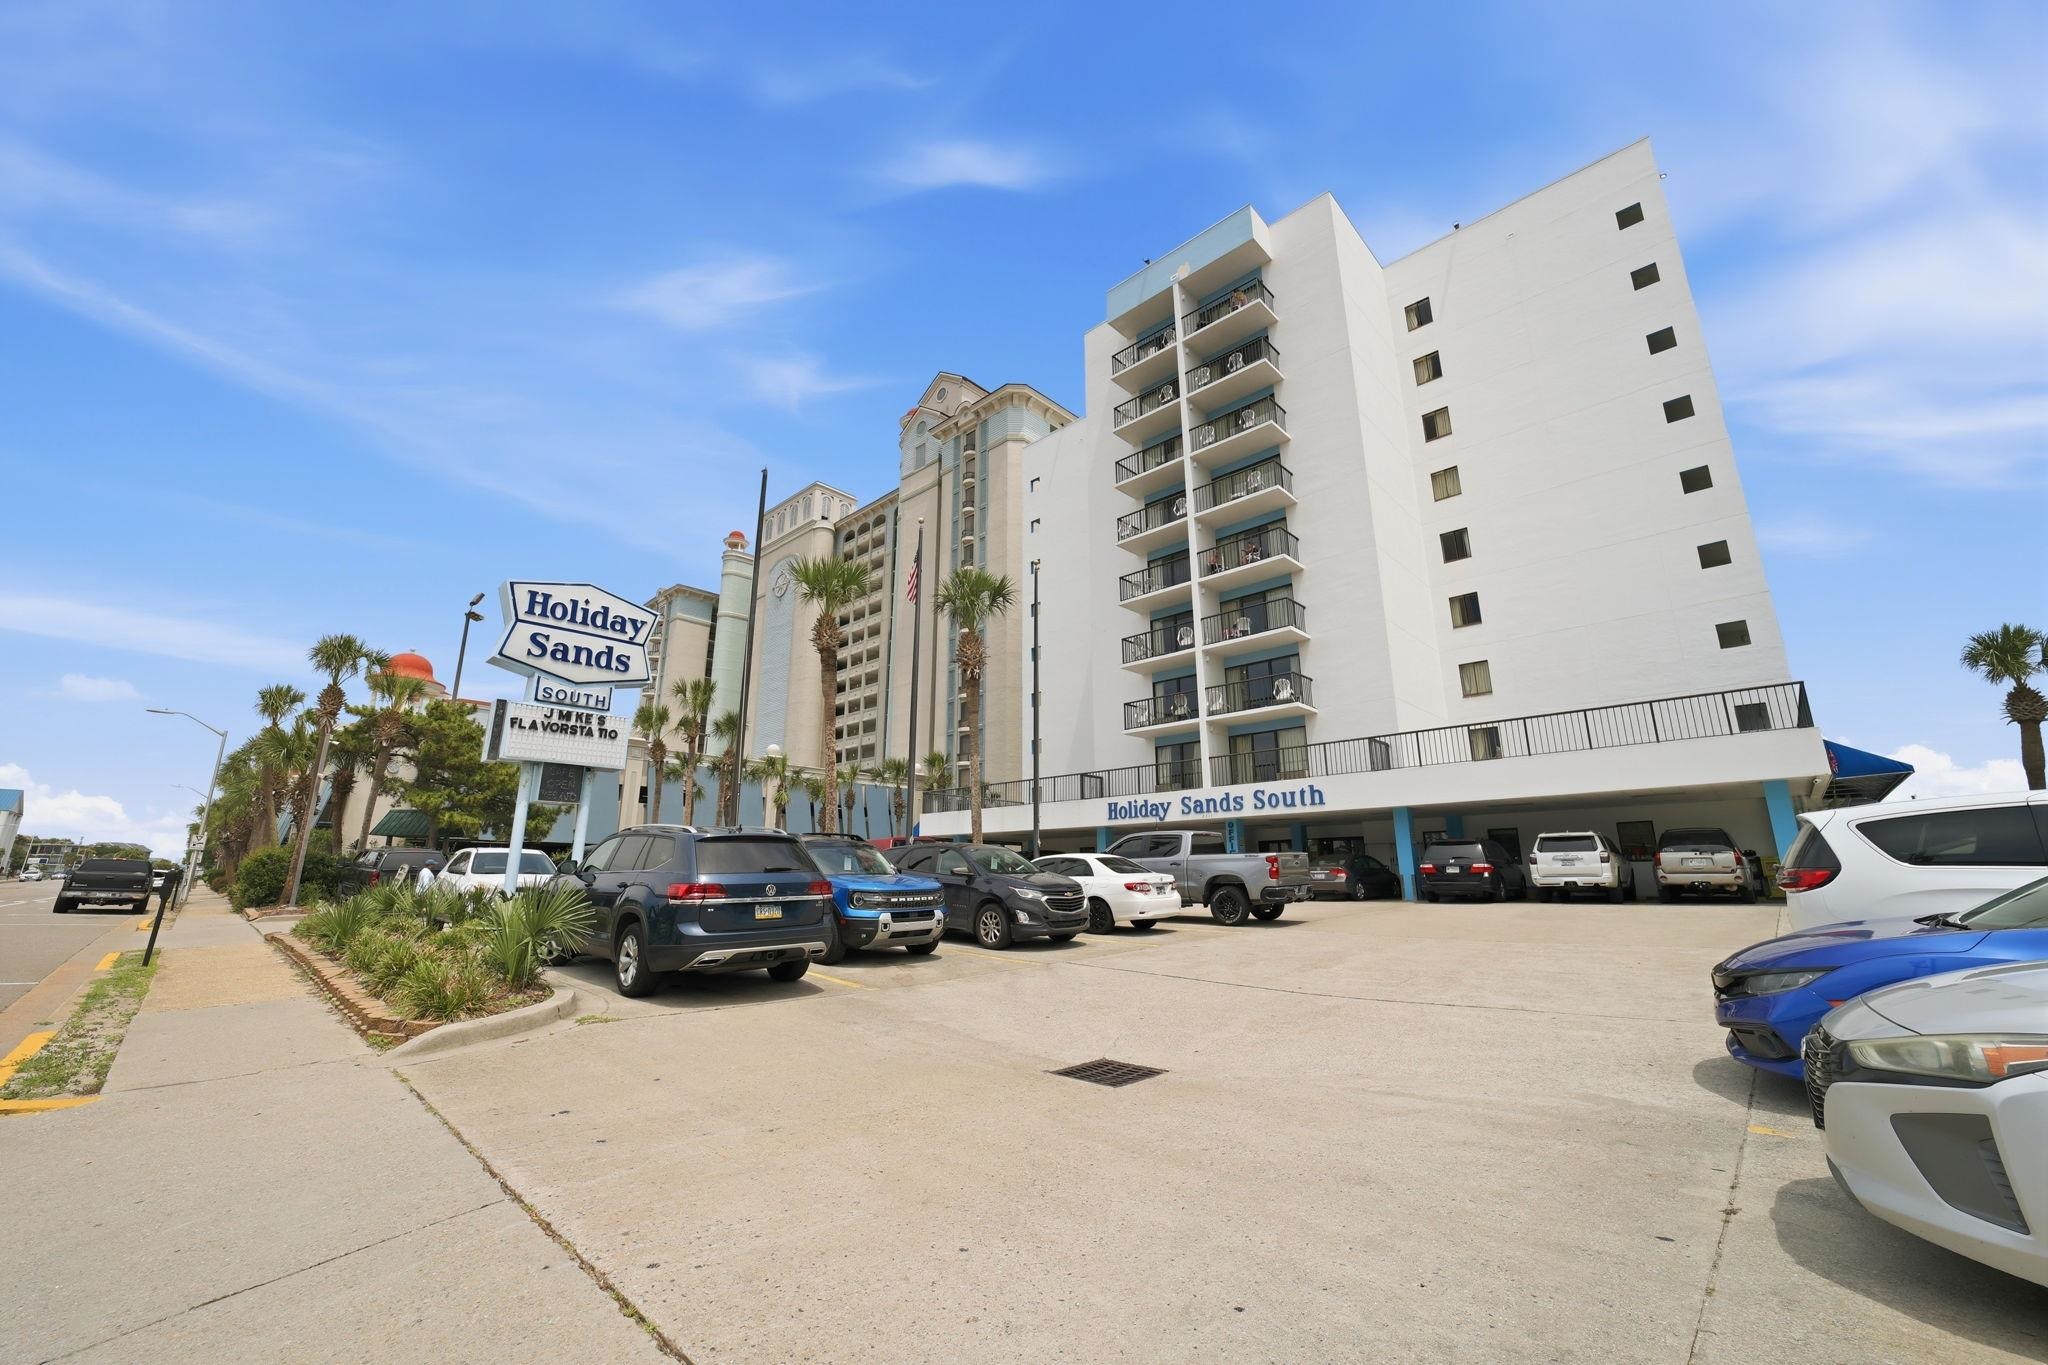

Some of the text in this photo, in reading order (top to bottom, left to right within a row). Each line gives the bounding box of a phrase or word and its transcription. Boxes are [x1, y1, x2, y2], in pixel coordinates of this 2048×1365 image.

[524, 589, 647, 641] Holiday
[526, 631, 631, 673] Sands
[542, 686, 606, 708] SOUTH
[1107, 784, 1326, 821] Holiday Sands South
